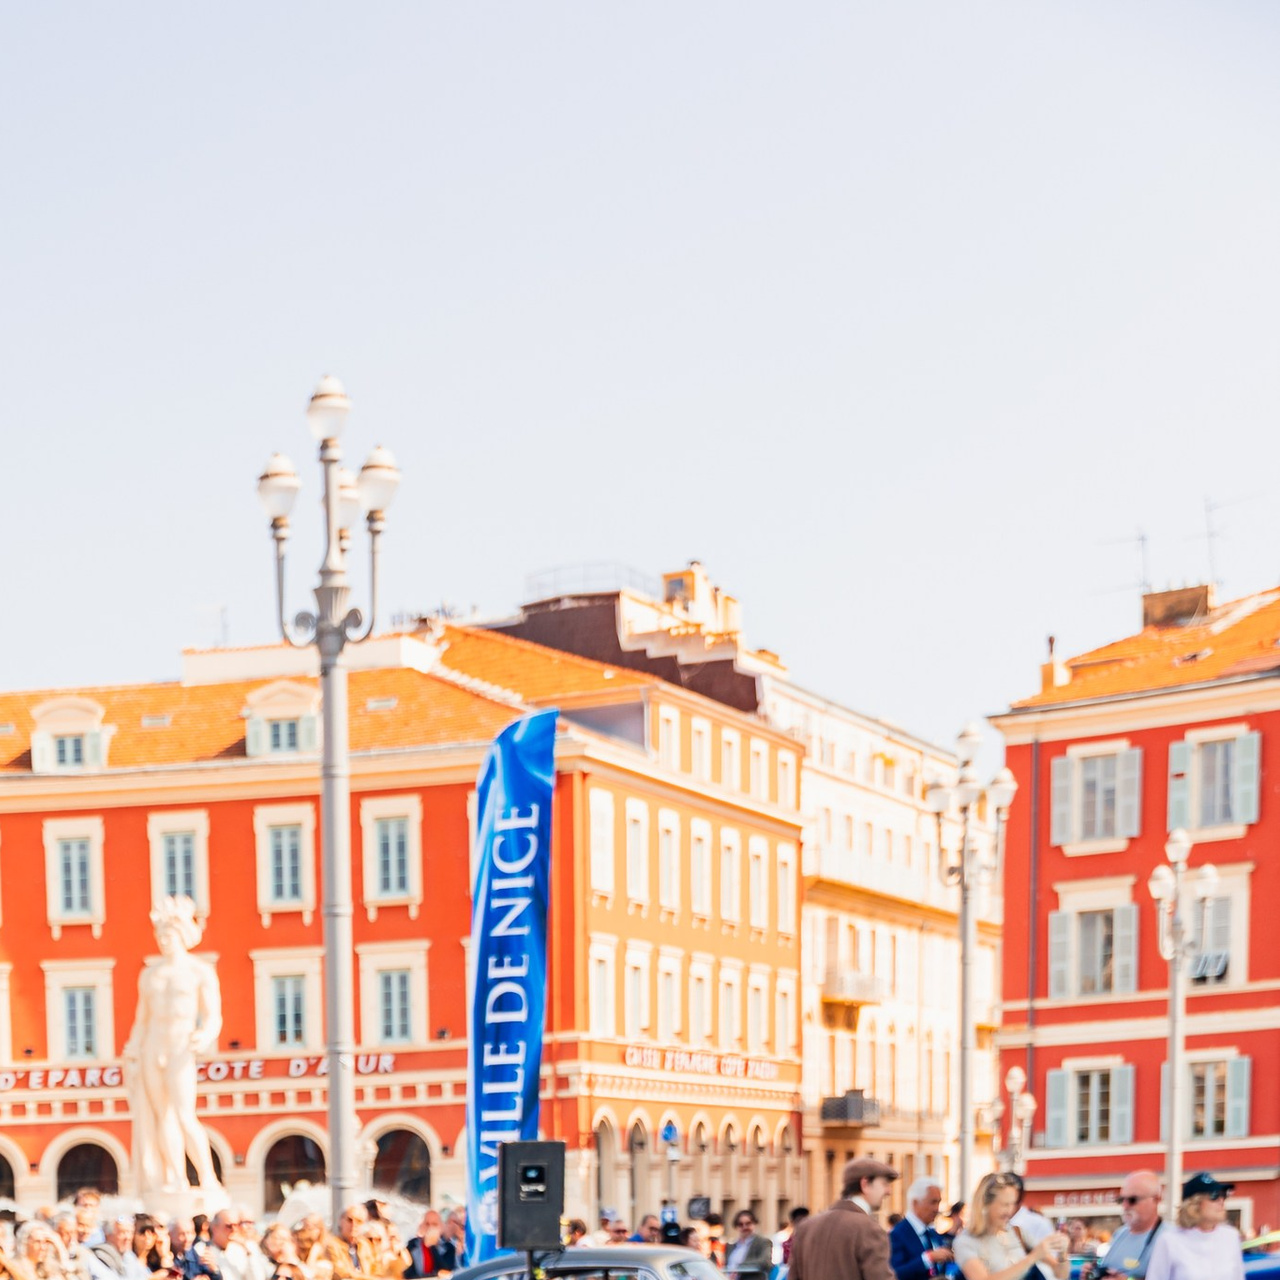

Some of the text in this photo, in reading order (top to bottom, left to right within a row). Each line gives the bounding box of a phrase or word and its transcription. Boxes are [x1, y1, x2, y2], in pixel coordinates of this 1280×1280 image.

[490, 803, 540, 937] NICE
[485, 953, 529, 1024] DE
[289, 1053, 395, 1078] D'AUR
